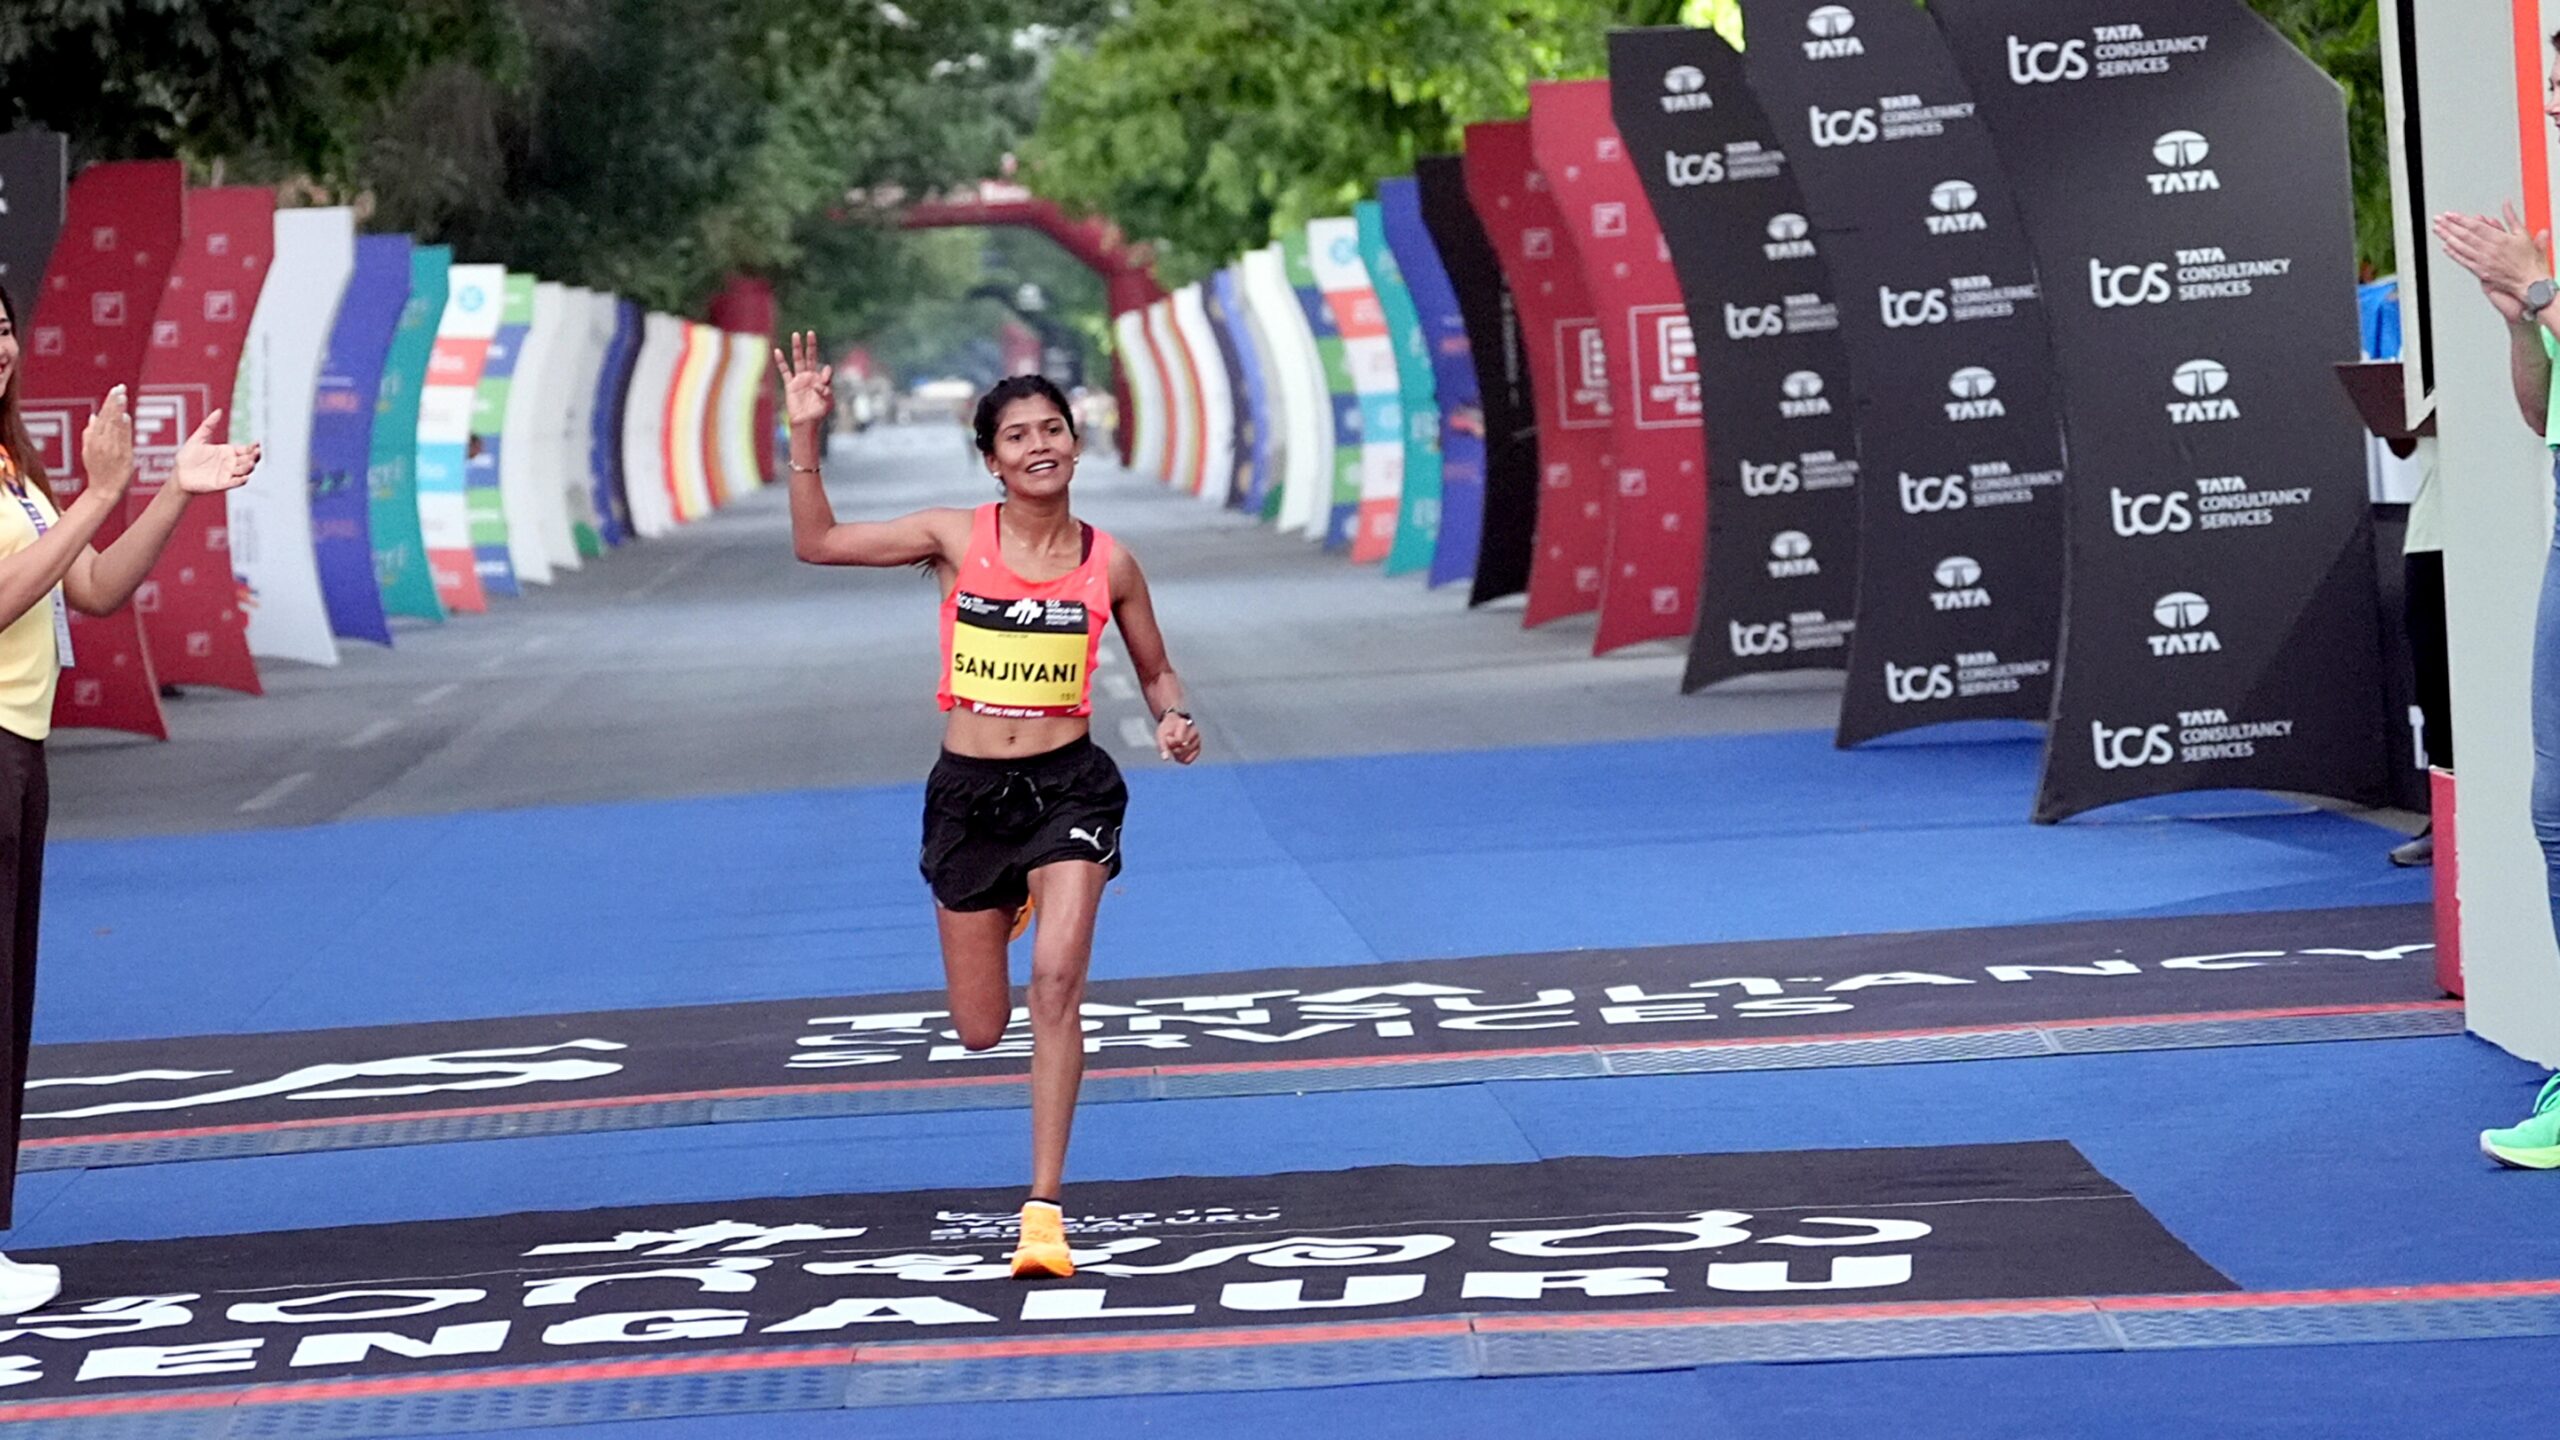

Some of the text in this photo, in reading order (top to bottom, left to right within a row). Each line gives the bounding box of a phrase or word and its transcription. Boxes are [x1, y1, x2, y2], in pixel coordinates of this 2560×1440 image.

[2093, 24, 2143, 41] TATA
[1802, 37, 1865, 60] TATA
[2008, 35, 2089, 85] tcs
[2094, 36, 2208, 60] CONSULTANCY
[2096, 57, 2170, 78] SERVICES
[1809, 105, 1878, 147] tcs
[1665, 150, 1725, 187] tcs
[2146, 170, 2221, 195] TATA
[1924, 211, 1988, 235] TATA
[2175, 247, 2226, 265] TATA
[2176, 258, 2292, 282] CONSULTANCY
[1949, 275, 1993, 291] TATA
[2090, 257, 2171, 309] tcs
[2178, 280, 2252, 301] SERVICES
[1879, 285, 1948, 328] tcs
[1724, 302, 1783, 340] tcs
[1779, 397, 1832, 419] TATA
[1945, 398, 2006, 422] TATA
[2166, 399, 2240, 424] TATA
[1740, 458, 1800, 497] tcs
[1968, 461, 2011, 478] TATA
[1899, 471, 1968, 514] tcs
[2196, 476, 2247, 494] TATA
[2110, 487, 2193, 537] tcs
[2198, 487, 2312, 512] CONSULTANCY
[2200, 509, 2273, 530] SERVICES
[1767, 556, 1821, 579] TATA
[1930, 588, 1992, 611] TATA
[1728, 619, 1790, 657] tcs
[2147, 631, 2222, 656] TATA
[954, 652, 1077, 683] SANJIVANI
[1955, 650, 1999, 667] TATA
[1884, 661, 1954, 704] tcs
[2177, 709, 2229, 727] TATA
[2091, 720, 2174, 769] tcs
[2179, 720, 2294, 745] CONSULTANCY
[2181, 742, 2255, 762] SERVICES
[785, 995, 1856, 1070] SERVICES
[0, 1254, 1914, 1388] ENGALURU
